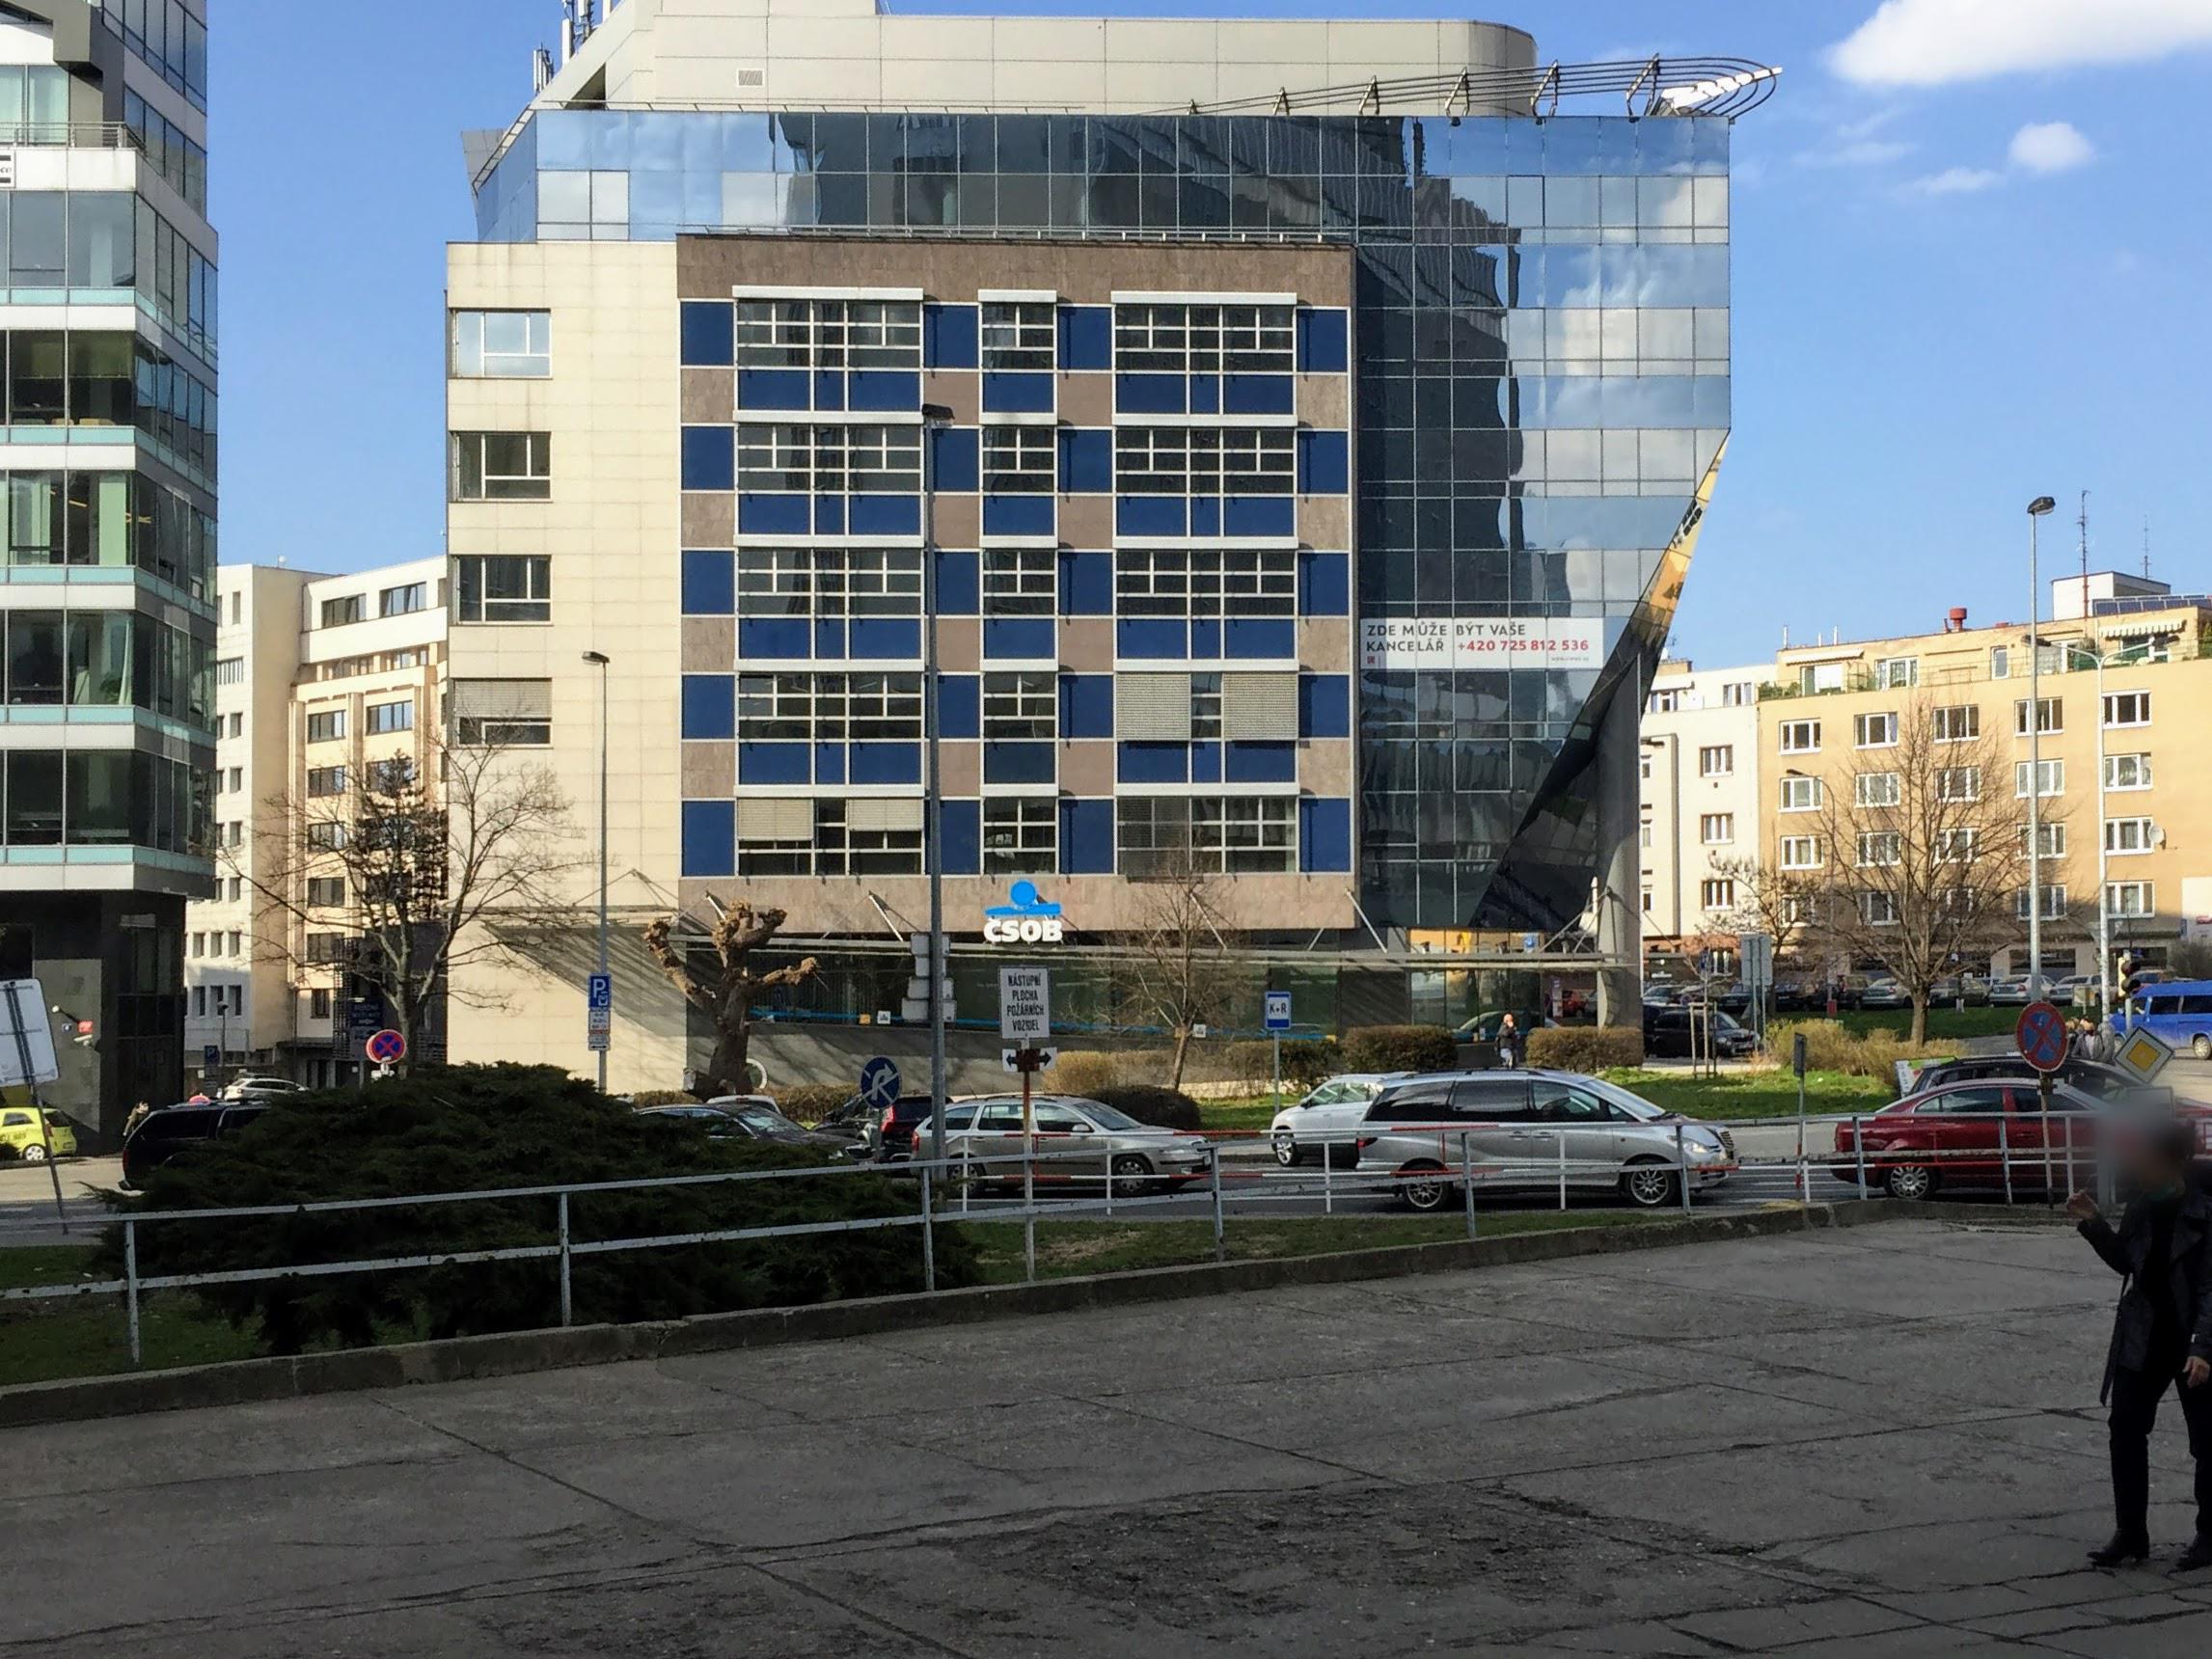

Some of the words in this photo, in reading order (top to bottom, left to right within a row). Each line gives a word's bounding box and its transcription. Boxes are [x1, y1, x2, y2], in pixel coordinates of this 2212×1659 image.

[1367, 625, 1396, 637] ZDE
[1403, 620, 1447, 637] MŮŽE
[1456, 621, 1484, 636] BÝT
[1490, 622, 1526, 636] VAŠE
[1366, 638, 1444, 652] KANCELÁŘ
[1458, 640, 1496, 651] +420
[1500, 640, 1527, 651] 725
[1530, 640, 1557, 651] 812
[1561, 640, 1590, 651] 536
[983, 916, 1063, 943] ČSOB
[1008, 972, 1041, 987] NÁSTUPNÍ
[592, 978, 607, 998] P
[1012, 990, 1039, 1001] PLOCHA
[1006, 1002, 1044, 1017] POŽÁRNÍCH
[1270, 1002, 1287, 1014] K+R
[1012, 1019, 1040, 1032] VOZIDEL
